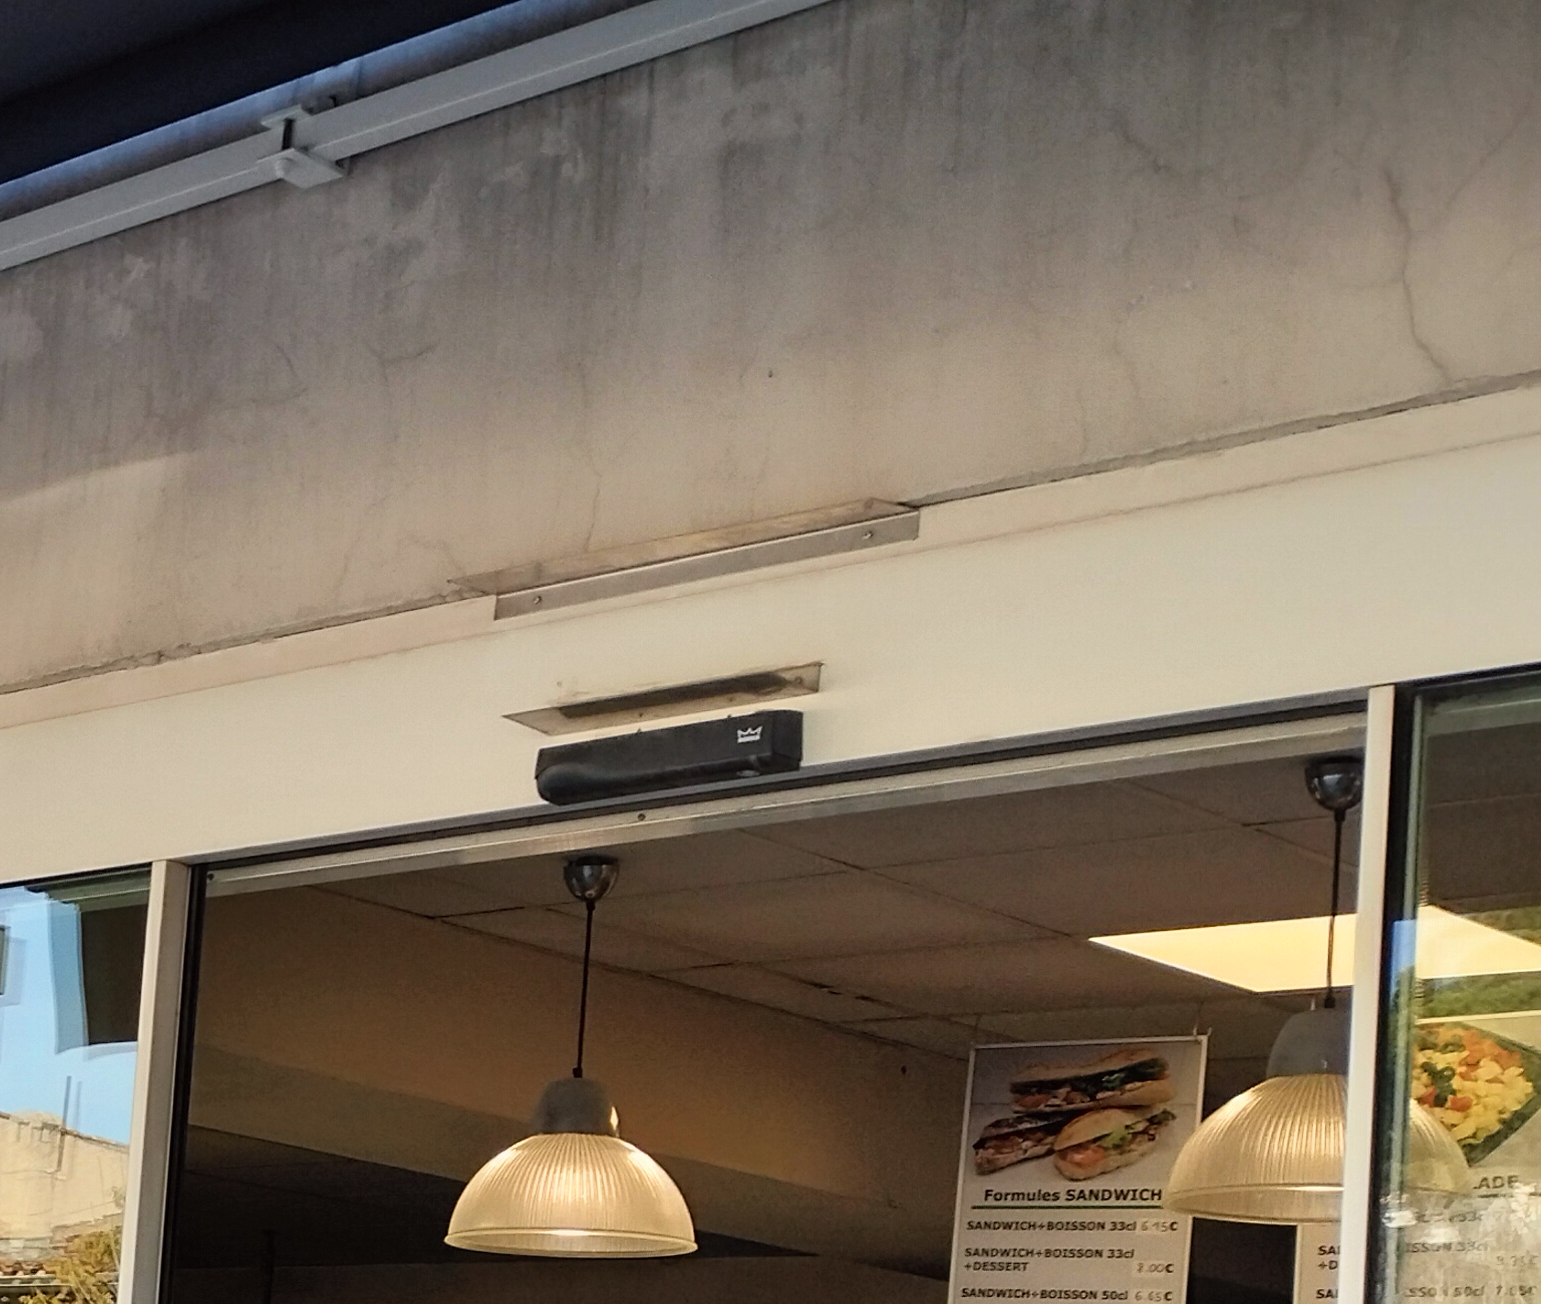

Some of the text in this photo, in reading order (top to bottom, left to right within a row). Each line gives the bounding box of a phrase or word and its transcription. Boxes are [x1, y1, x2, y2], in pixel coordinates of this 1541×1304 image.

[984, 1189, 1162, 1201] Formules SANDWICH
[964, 1261, 1029, 1271] +DESSERT
